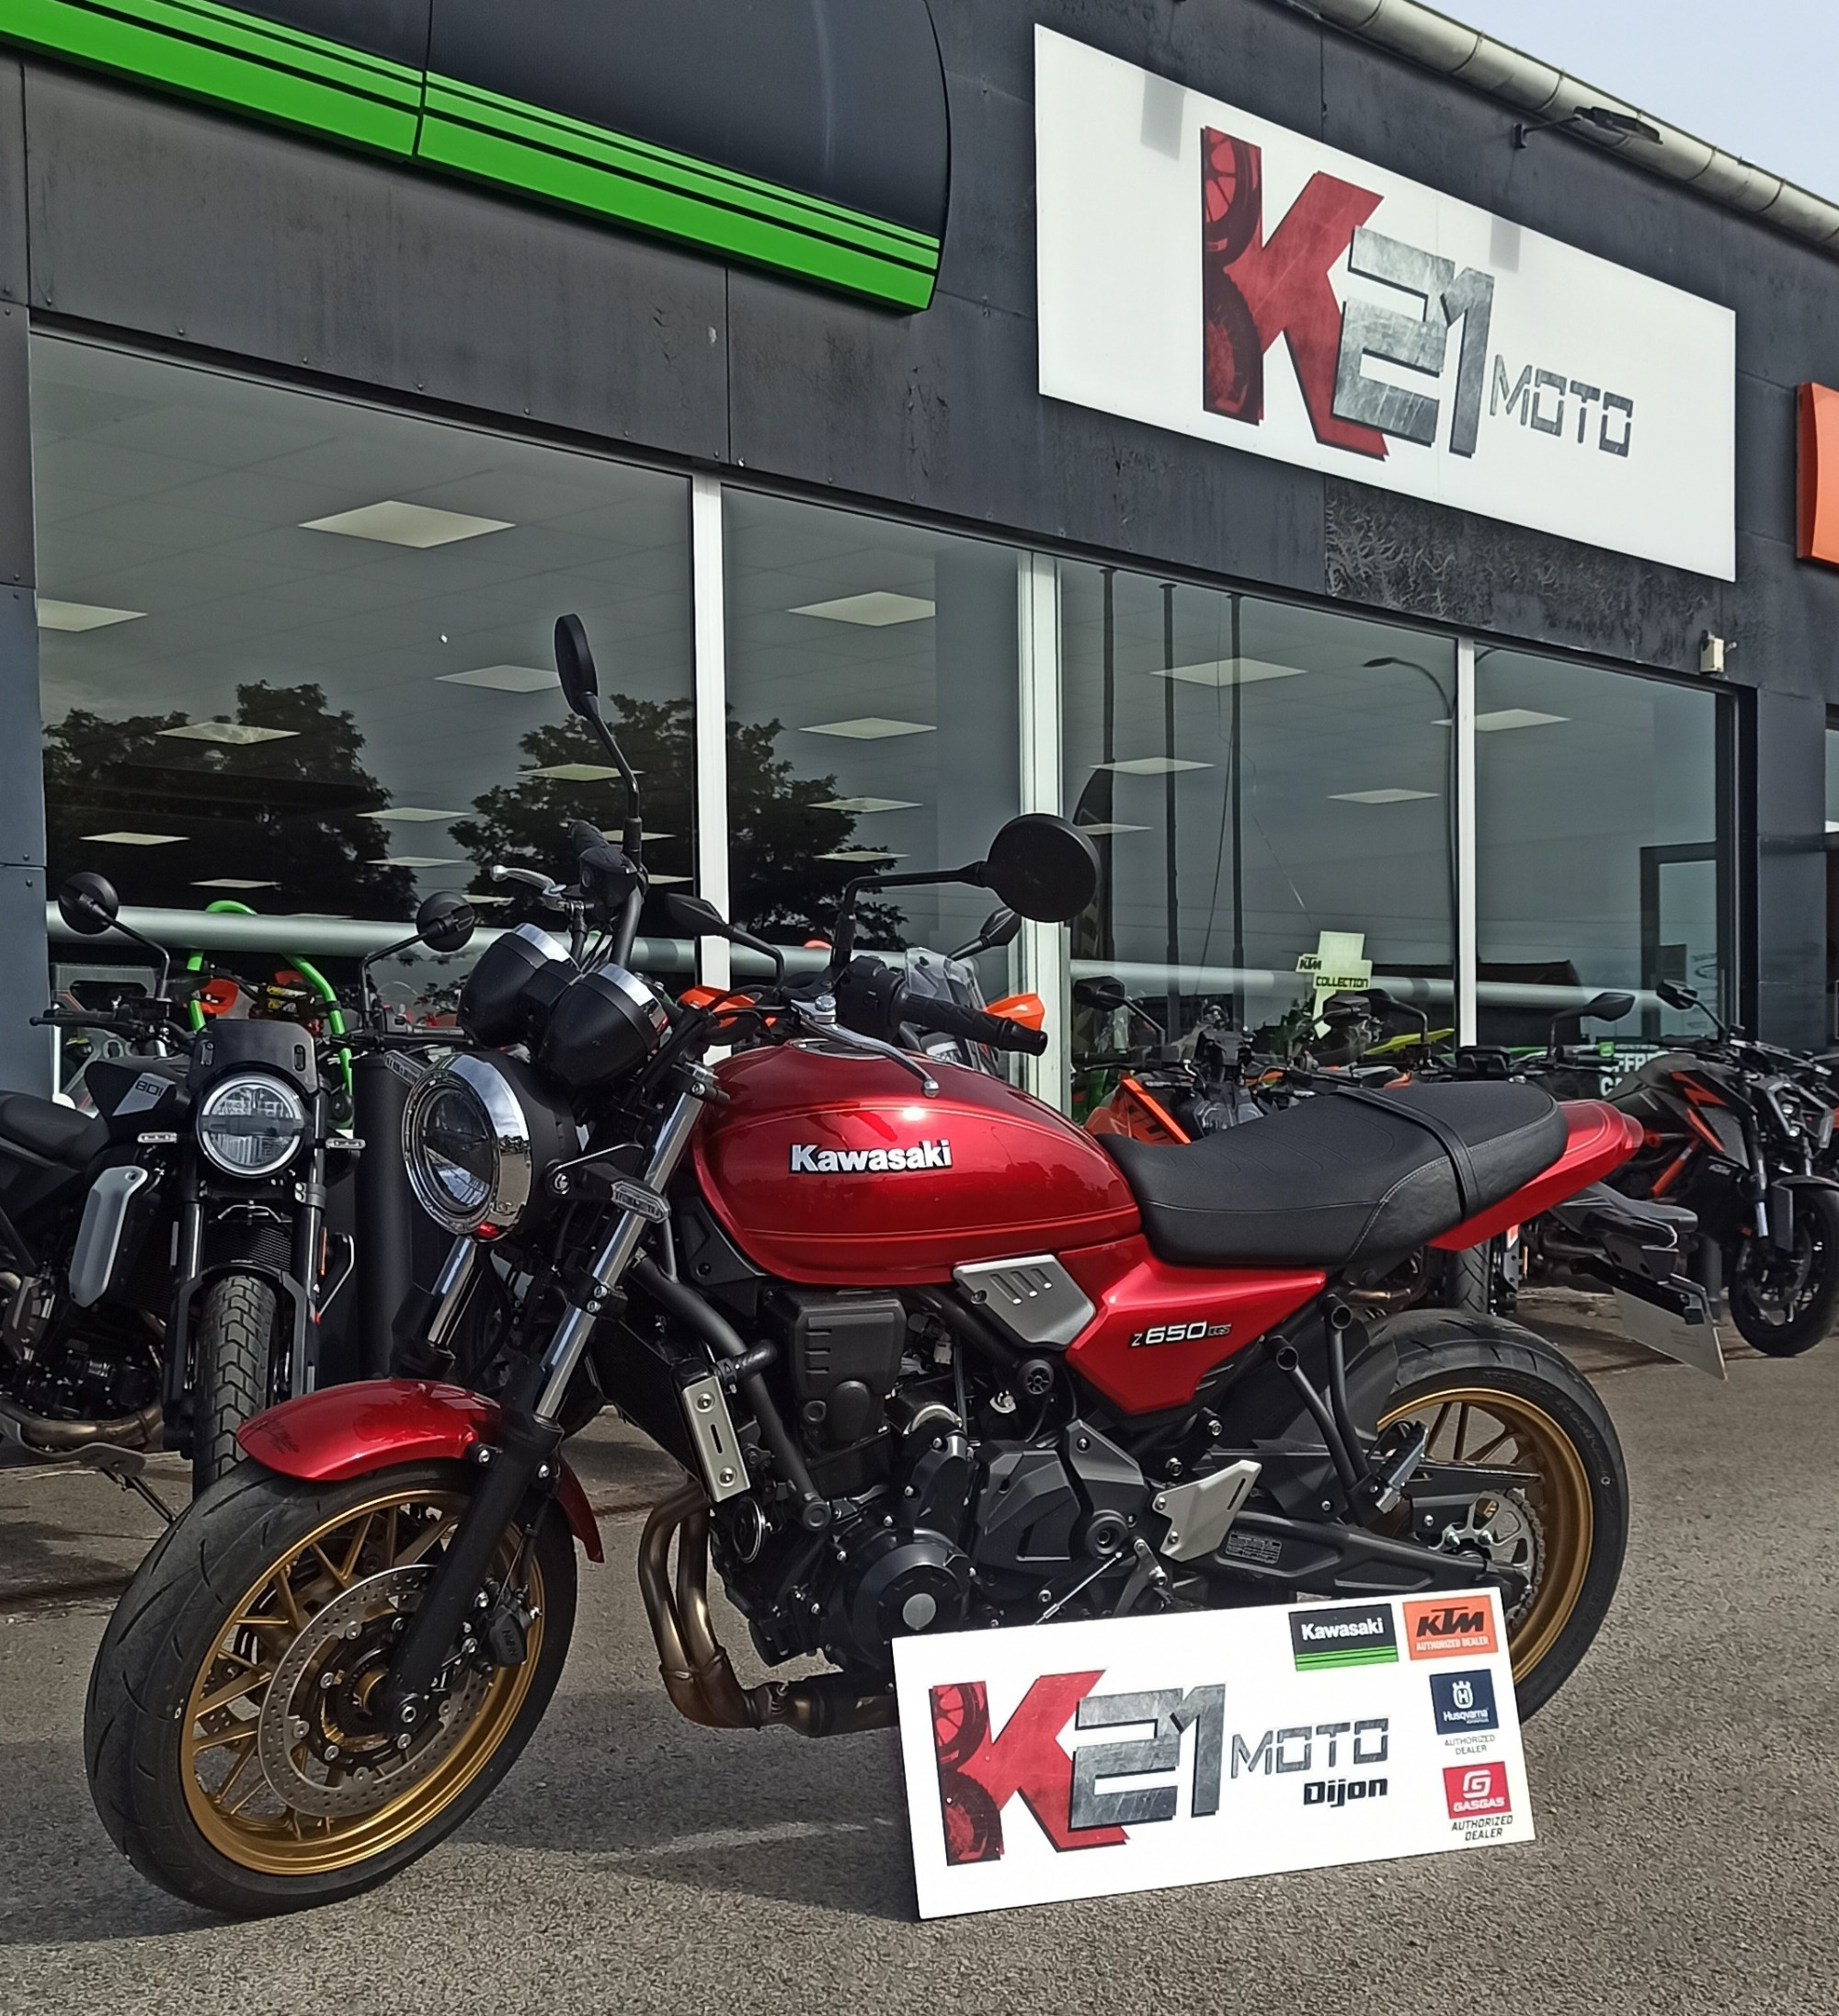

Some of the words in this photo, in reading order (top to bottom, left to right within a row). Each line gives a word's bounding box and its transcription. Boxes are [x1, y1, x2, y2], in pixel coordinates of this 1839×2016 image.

[1200, 126, 1495, 461] K21
[1490, 354, 1634, 458] MOTO
[1298, 956, 1322, 970] KTM
[1316, 976, 1368, 988] COLLECTION
[790, 1139, 953, 1173] Kawasaki
[1300, 1617, 1385, 1641] Kawasaki
[1416, 1607, 1485, 1637] KTM
[1416, 1639, 1461, 1651] AUTHORIZED
[1461, 1636, 1489, 1647] DEALER
[1443, 1709, 1489, 1722] Husqvarna
[1445, 1734, 1495, 1746] AUTHORIZED
[1455, 1745, 1487, 1755] DEALER
[929, 1669, 1227, 1867] K21
[1231, 1718, 1389, 1779] MOTO
[1303, 1778, 1388, 1808] Dijon
[1453, 1796, 1505, 1812] GASGAS
[1451, 1815, 1513, 1831] AUTHORIZED
[1465, 1828, 1503, 1841] DEALER
